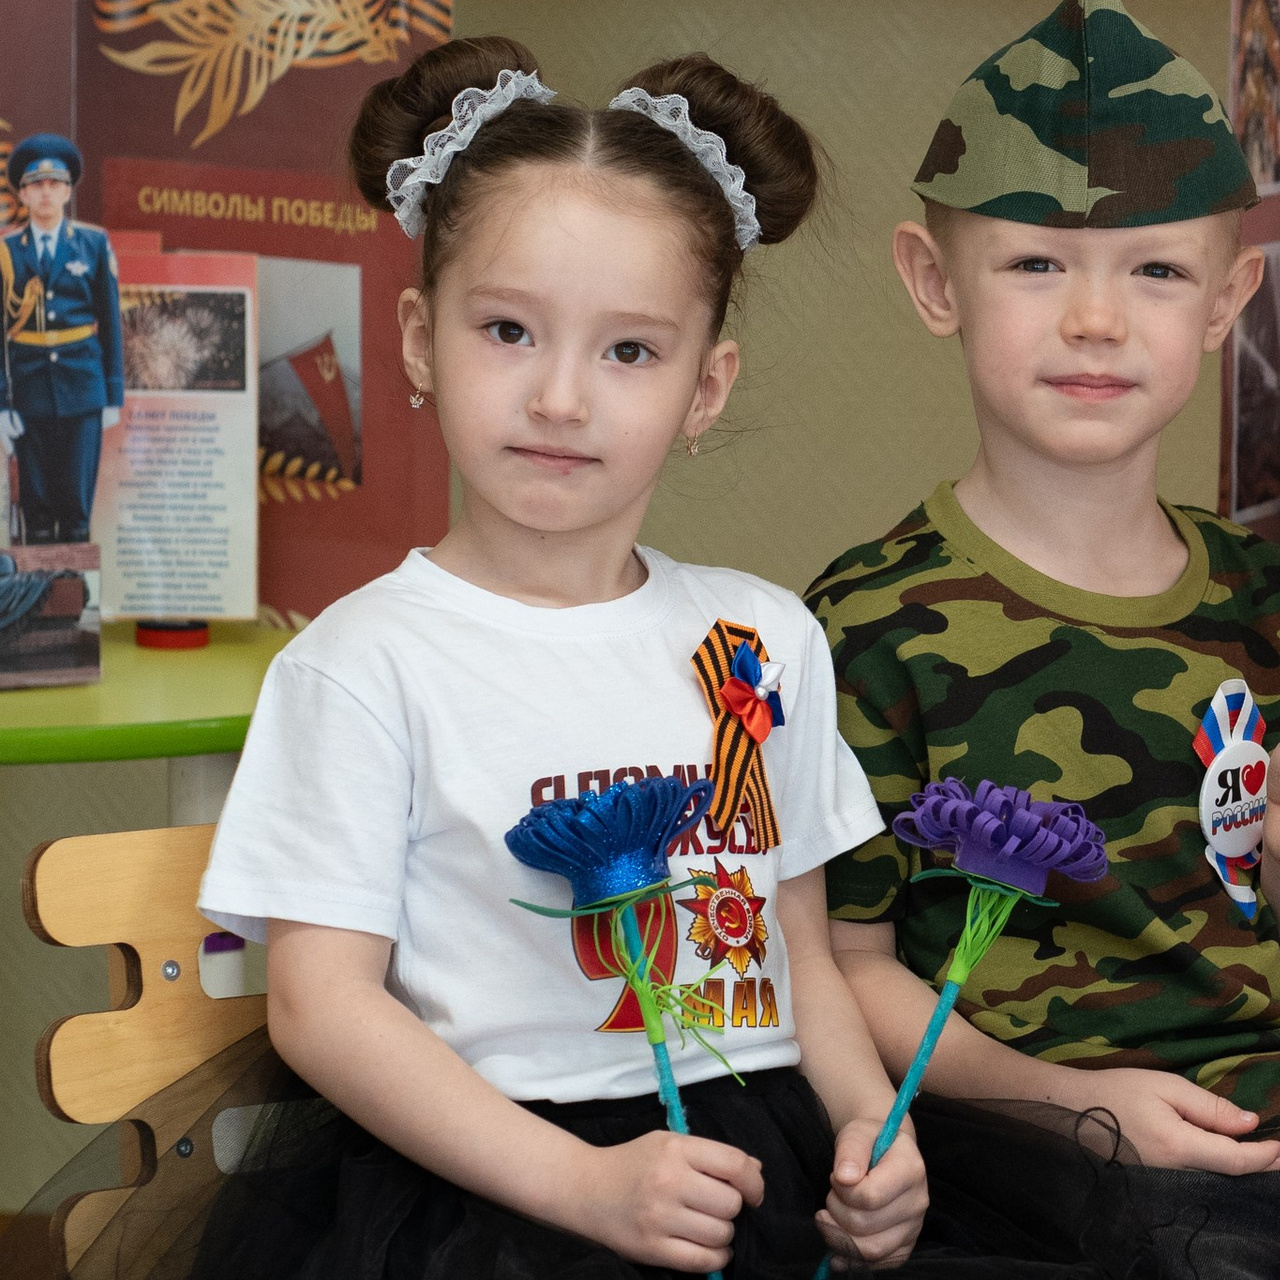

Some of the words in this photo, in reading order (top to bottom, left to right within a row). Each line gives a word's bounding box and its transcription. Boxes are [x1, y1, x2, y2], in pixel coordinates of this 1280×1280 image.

[137, 185, 266, 222] СИМВОЛЫ
[270, 196, 379, 236] ПОБЕДЫ
[1215, 766, 1242, 808] Я
[709, 889, 748, 942] ОТЕЧЕСТВЕННАЯ
[681, 977, 779, 1029] МАЯ
